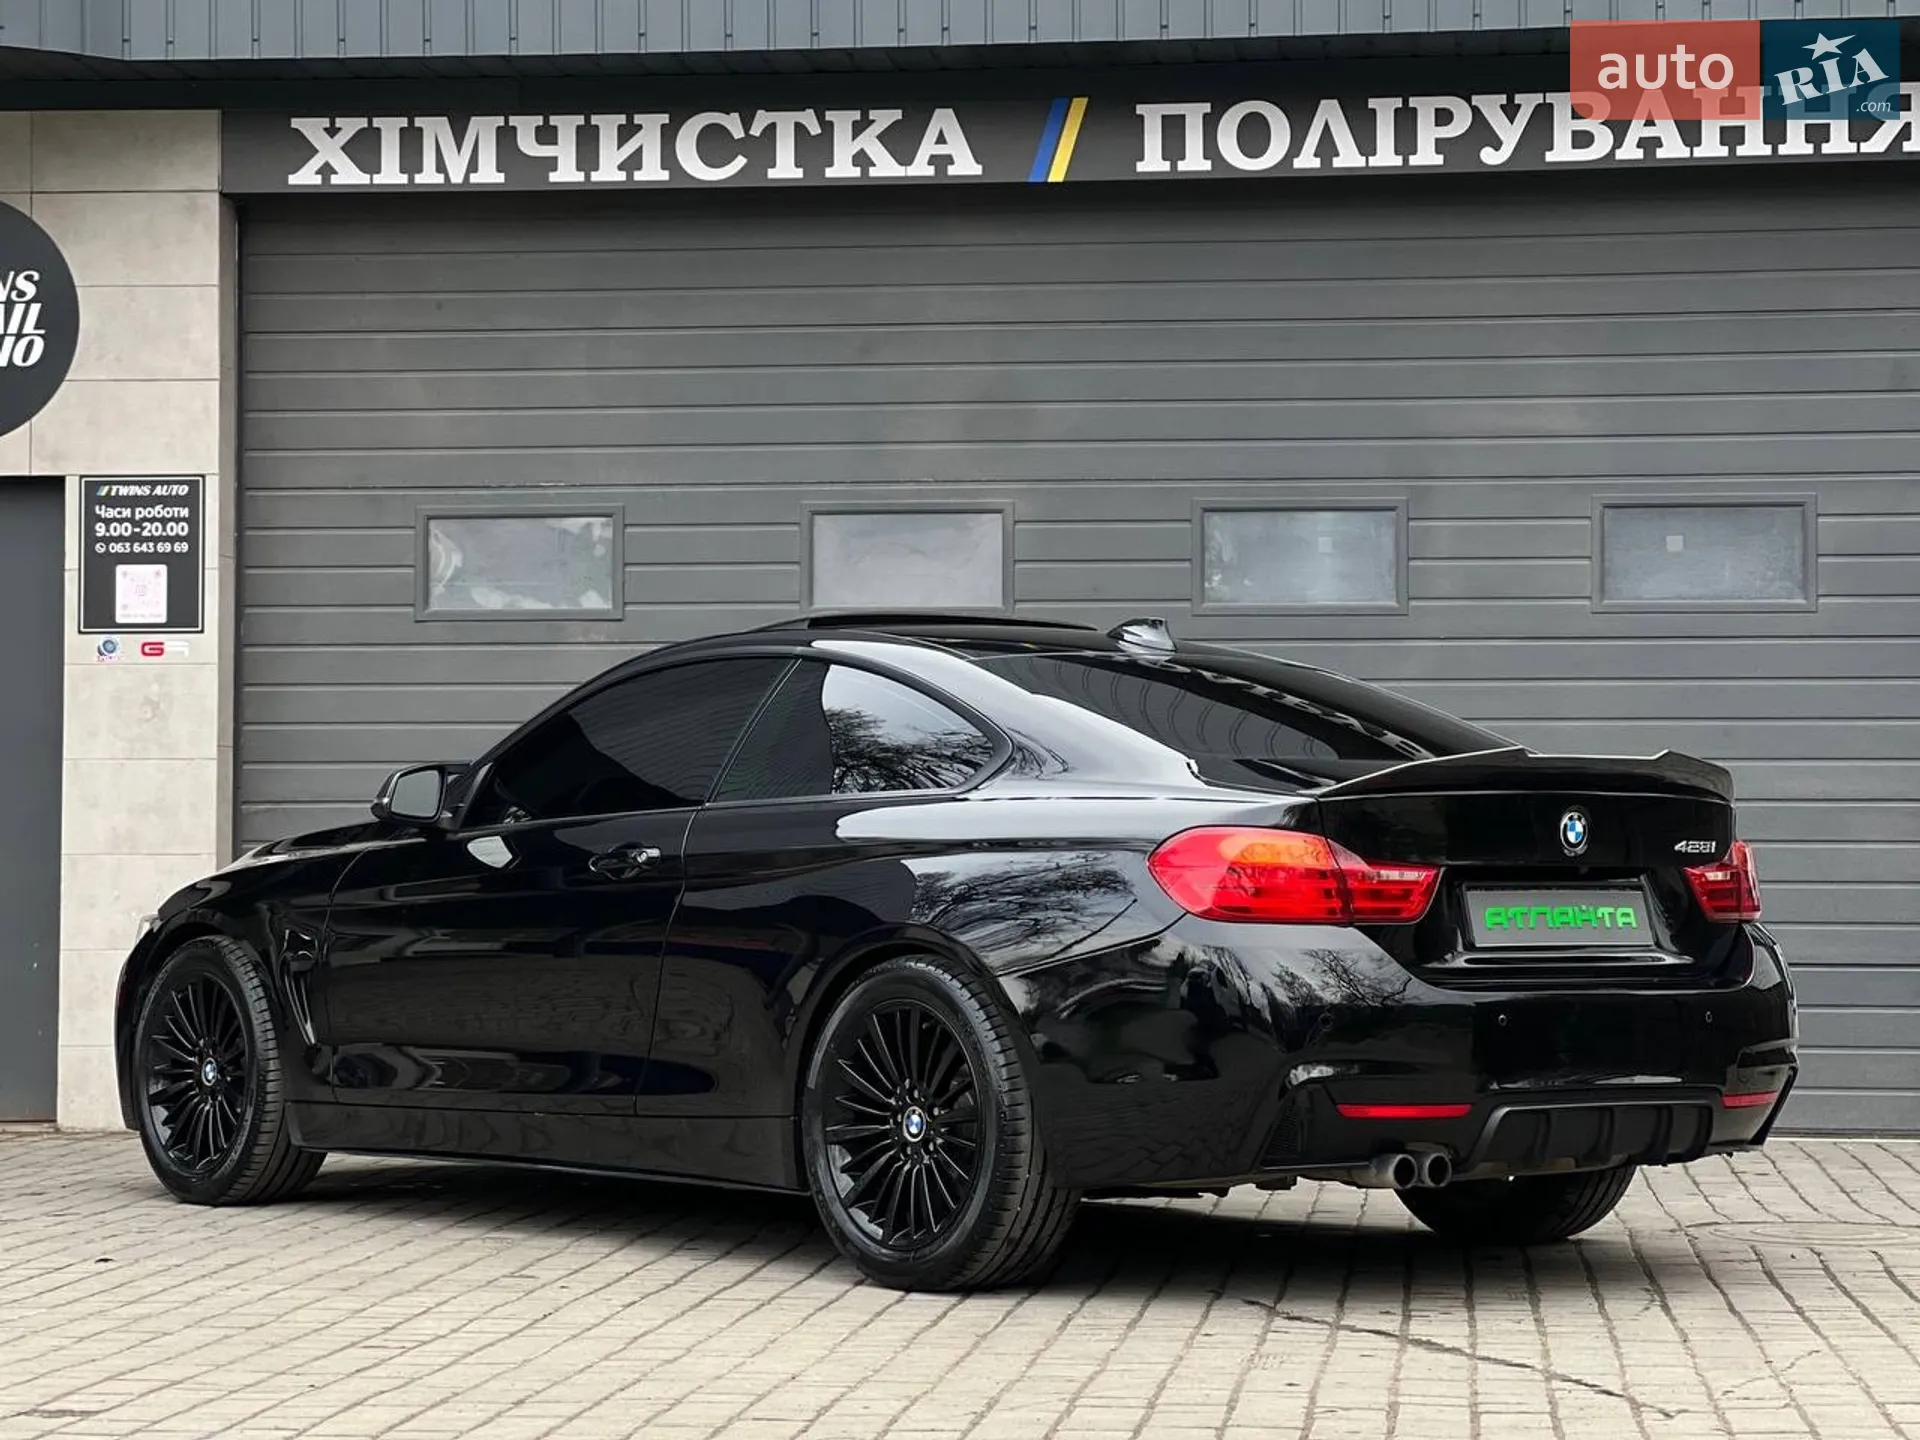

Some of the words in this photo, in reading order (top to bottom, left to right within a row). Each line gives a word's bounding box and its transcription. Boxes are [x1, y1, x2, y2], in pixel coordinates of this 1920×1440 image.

[287, 108, 983, 186] ХІМЧИСТКА
[1135, 80, 1920, 173] ПОЛІРУВАННЯ
[110, 484, 151, 496] TWINS
[151, 484, 189, 496] AUTO
[95, 504, 132, 519] Часи
[135, 504, 189, 521] роботи
[108, 541, 131, 554] 063
[133, 541, 154, 554] 643
[156, 541, 172, 554] 69
[174, 541, 189, 554] 69
